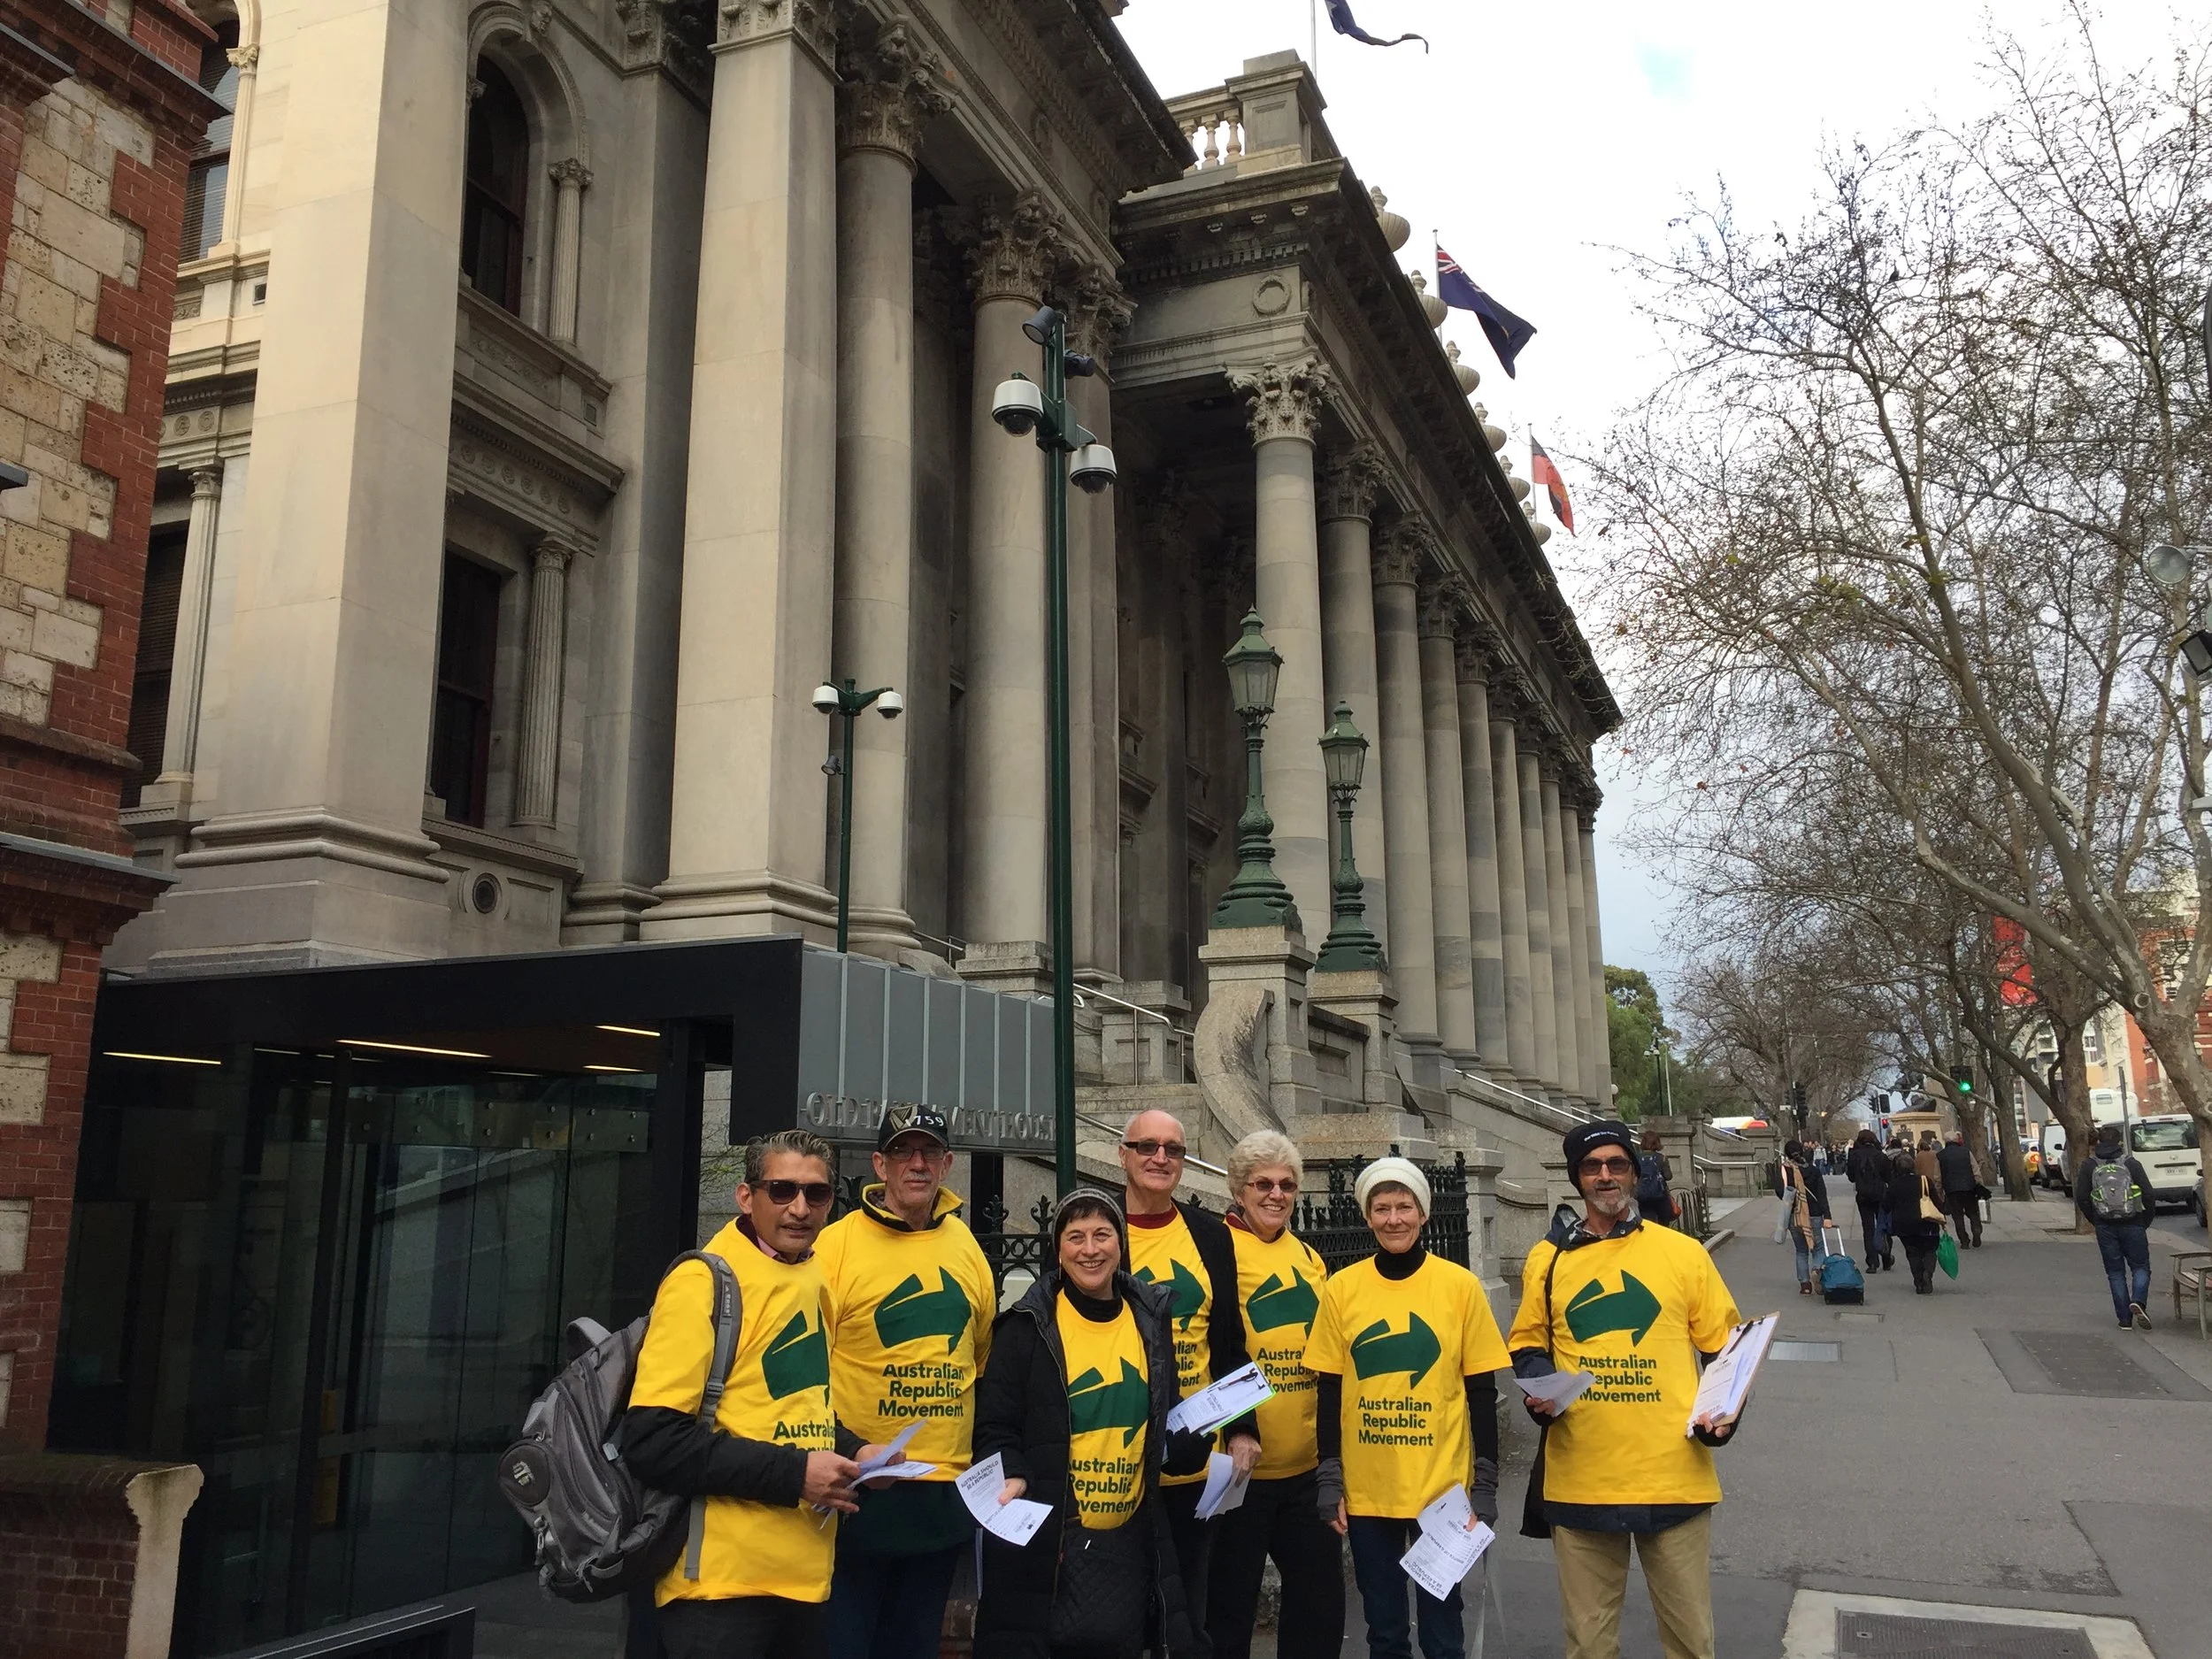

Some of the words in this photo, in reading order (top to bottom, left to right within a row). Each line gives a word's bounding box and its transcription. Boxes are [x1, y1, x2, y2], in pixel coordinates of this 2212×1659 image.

[905, 1115, 944, 1127] 1759
[1256, 1346, 1306, 1360] Austral
[1578, 1354, 1657, 1369] Australian
[882, 1363, 964, 1380] Australian
[1264, 1363, 1316, 1380] Repub
[1586, 1371, 1653, 1389] epublic
[889, 1380, 962, 1402] Republic
[1269, 1379, 1317, 1393] ovemen
[1579, 1387, 1661, 1402] Movement
[878, 1399, 964, 1417] Movement
[1358, 1396, 1432, 1412] Australian
[772, 1418, 835, 1440] Austral
[1363, 1413, 1426, 1432] Republic
[1358, 1430, 1433, 1446] Movement
[1069, 1456, 1140, 1475] ustralian
[1079, 1495, 1137, 1514] vement
